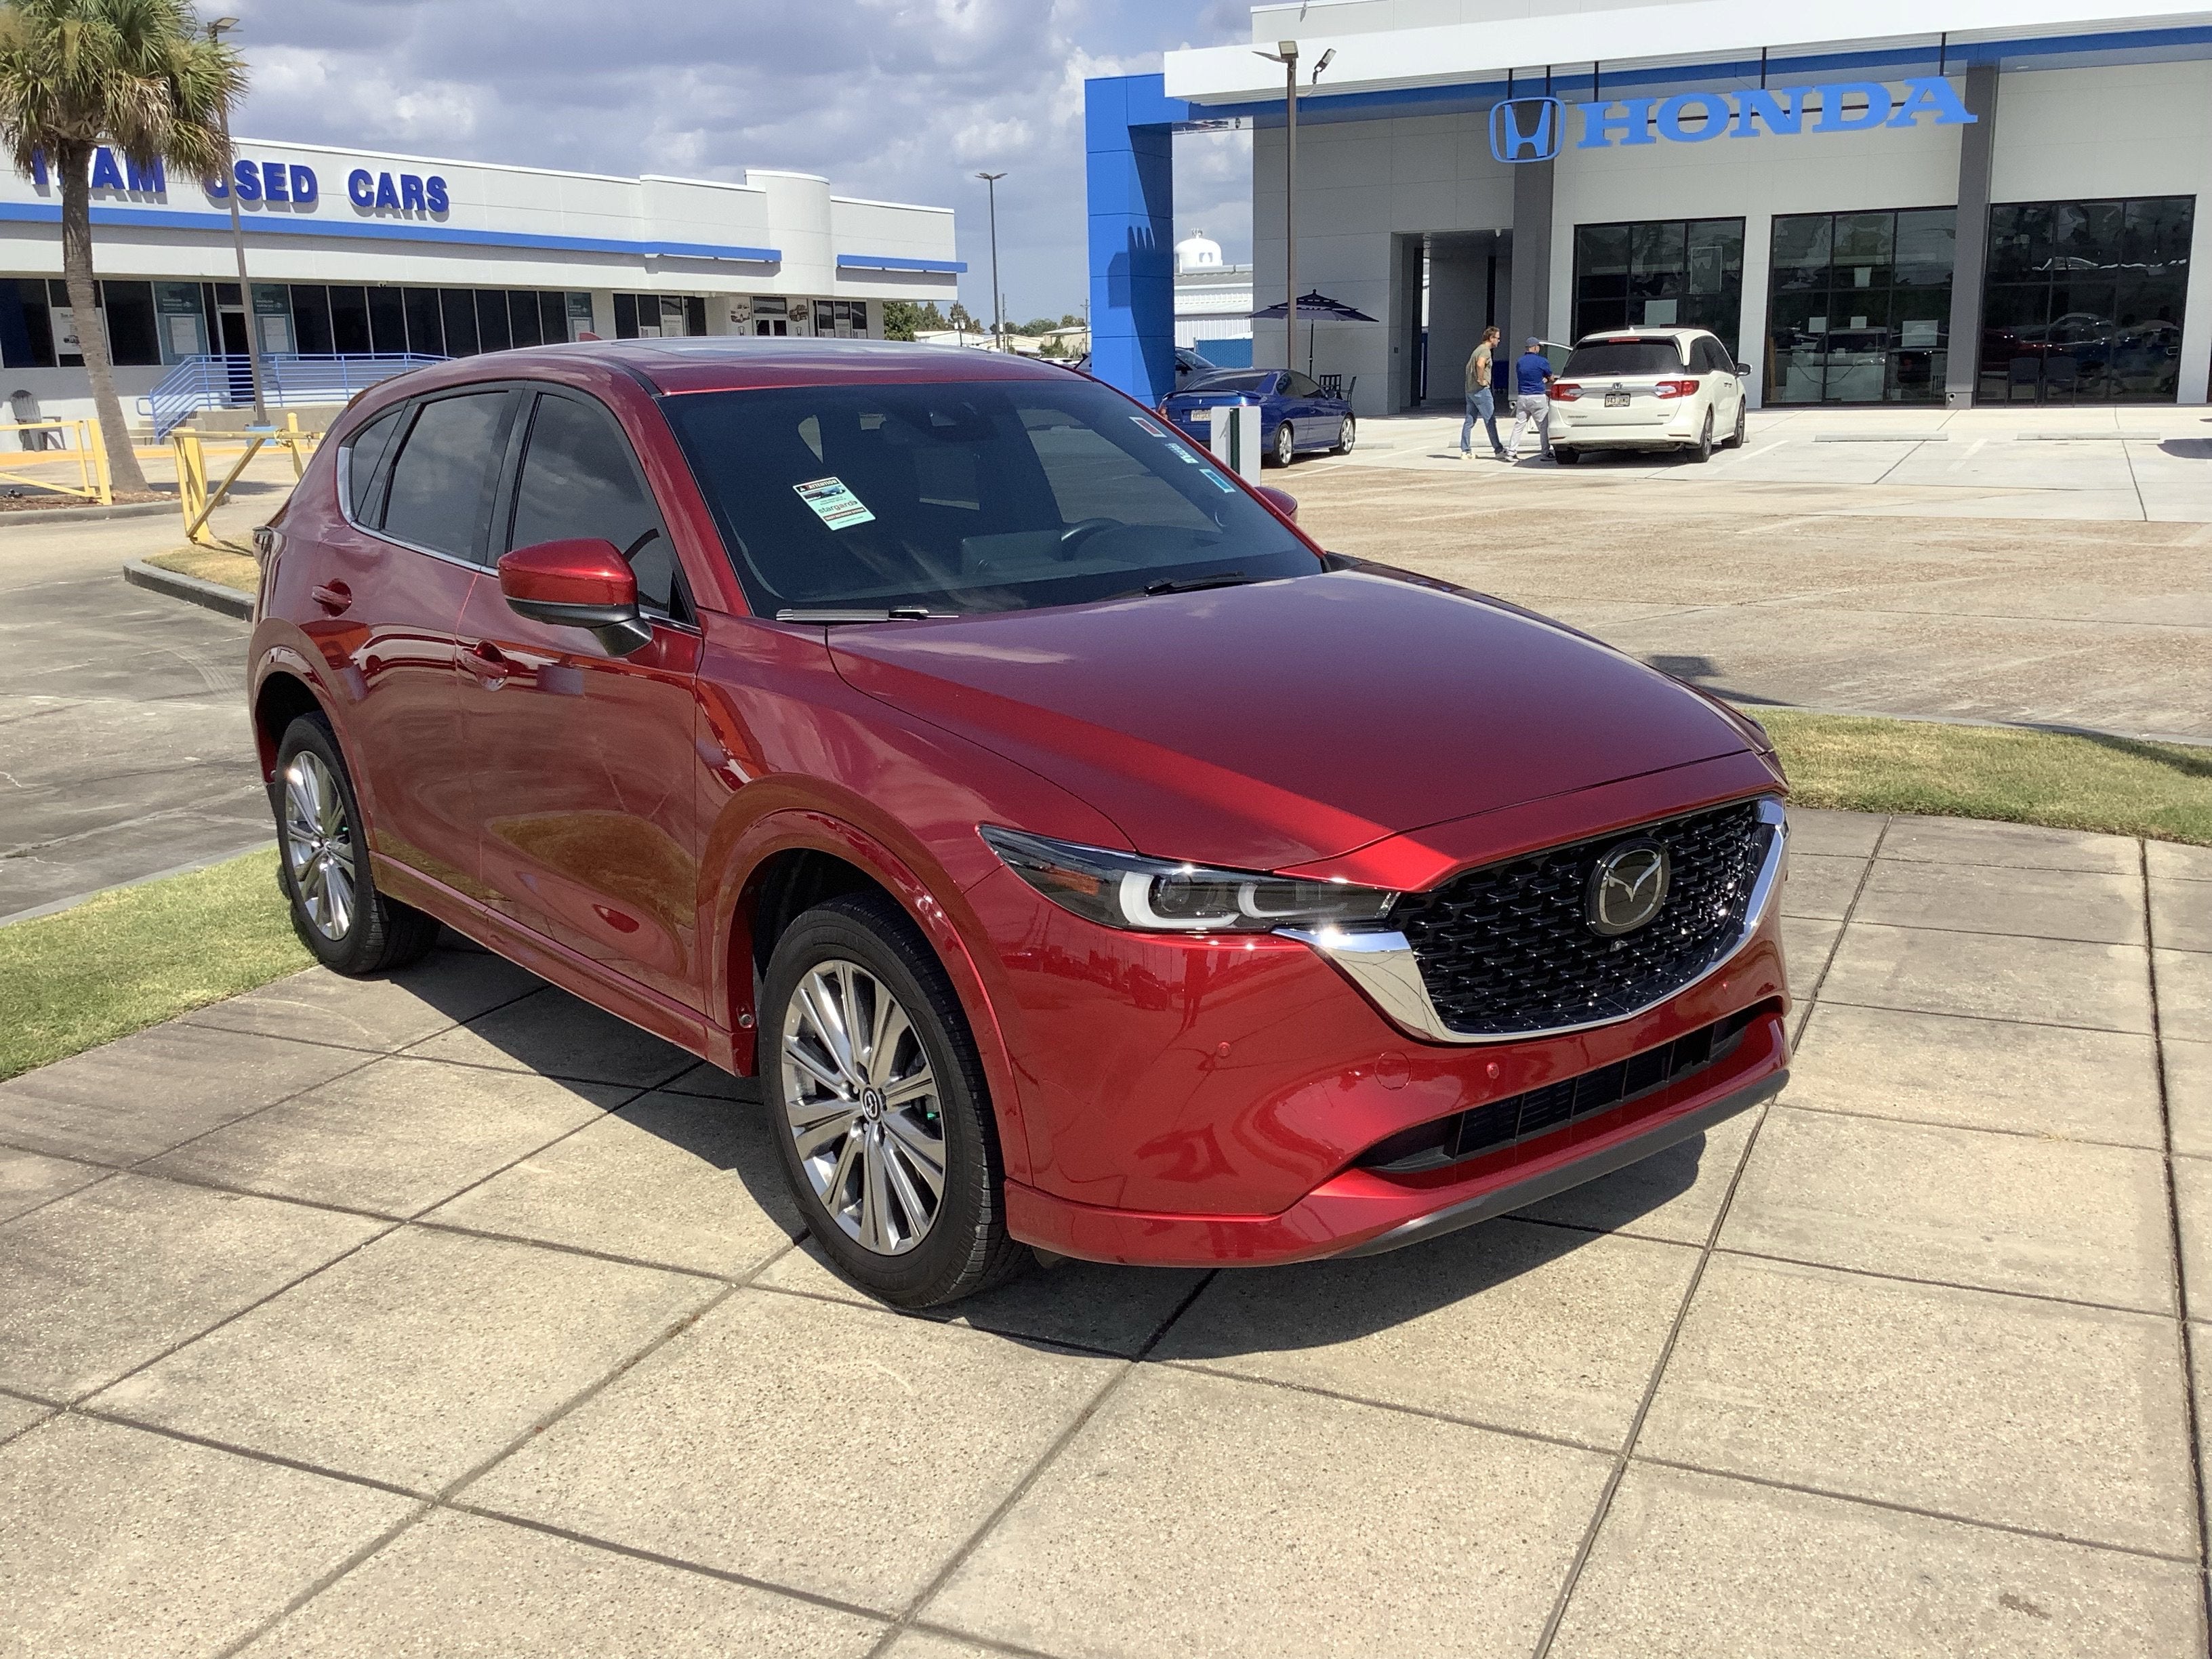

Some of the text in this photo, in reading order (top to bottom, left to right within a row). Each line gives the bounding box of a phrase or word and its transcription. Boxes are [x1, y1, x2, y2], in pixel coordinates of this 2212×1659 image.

[1576, 76, 1978, 149] HONDA
[30, 144, 165, 193] AM
[348, 169, 449, 213] CARS
[808, 478, 838, 489] ATTENTION
